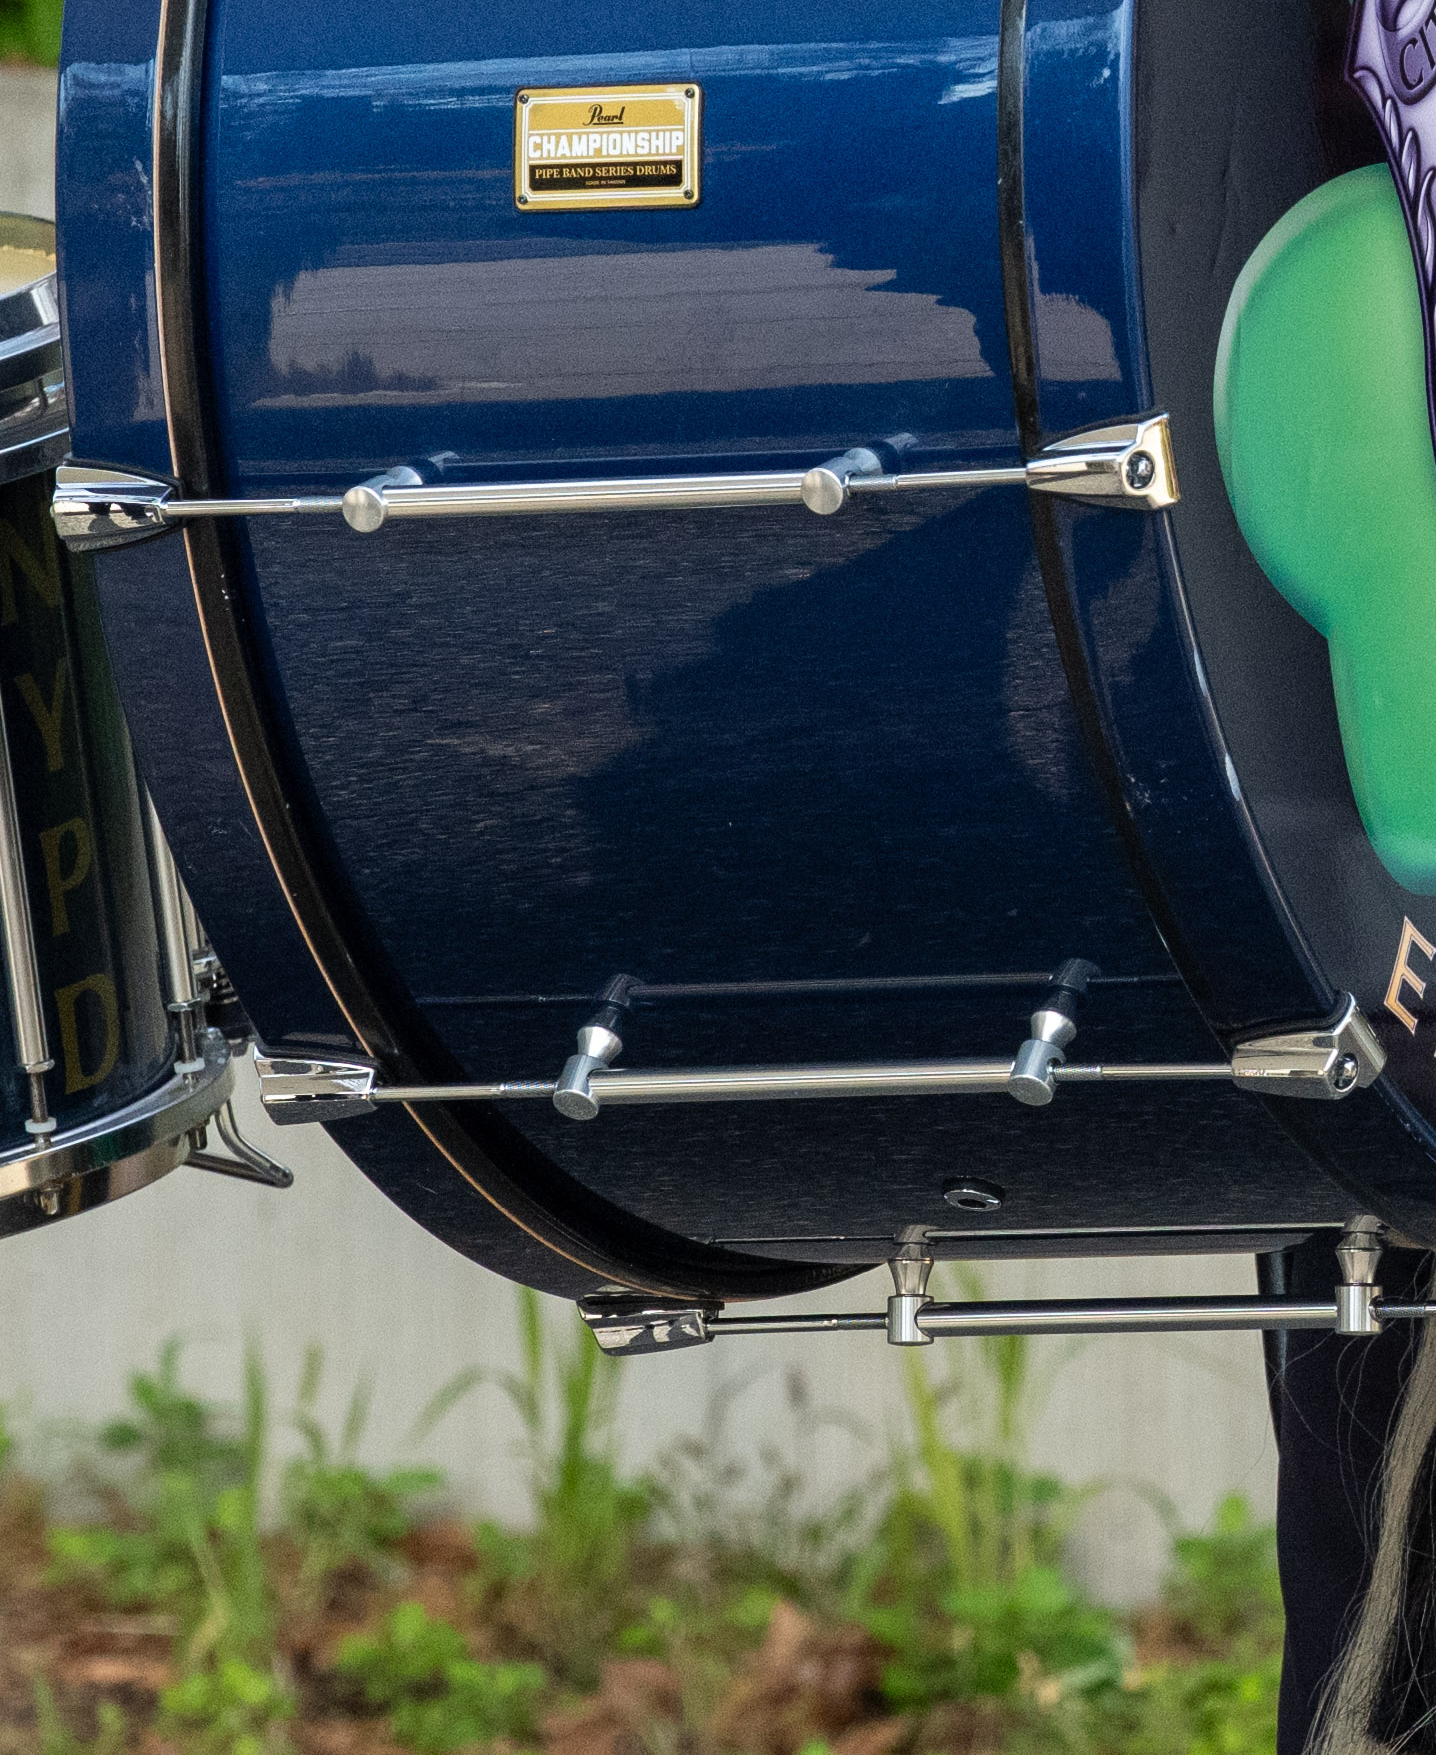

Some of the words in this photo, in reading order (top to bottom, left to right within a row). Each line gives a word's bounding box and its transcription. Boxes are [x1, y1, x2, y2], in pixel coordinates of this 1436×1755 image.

[582, 104, 626, 126] Pearl
[527, 130, 685, 158] CHAMPIONSHIP
[534, 168, 560, 179] PIPE
[562, 167, 594, 178] BAND
[595, 165, 634, 177] SERIES
[636, 164, 677, 176] DRUMS
